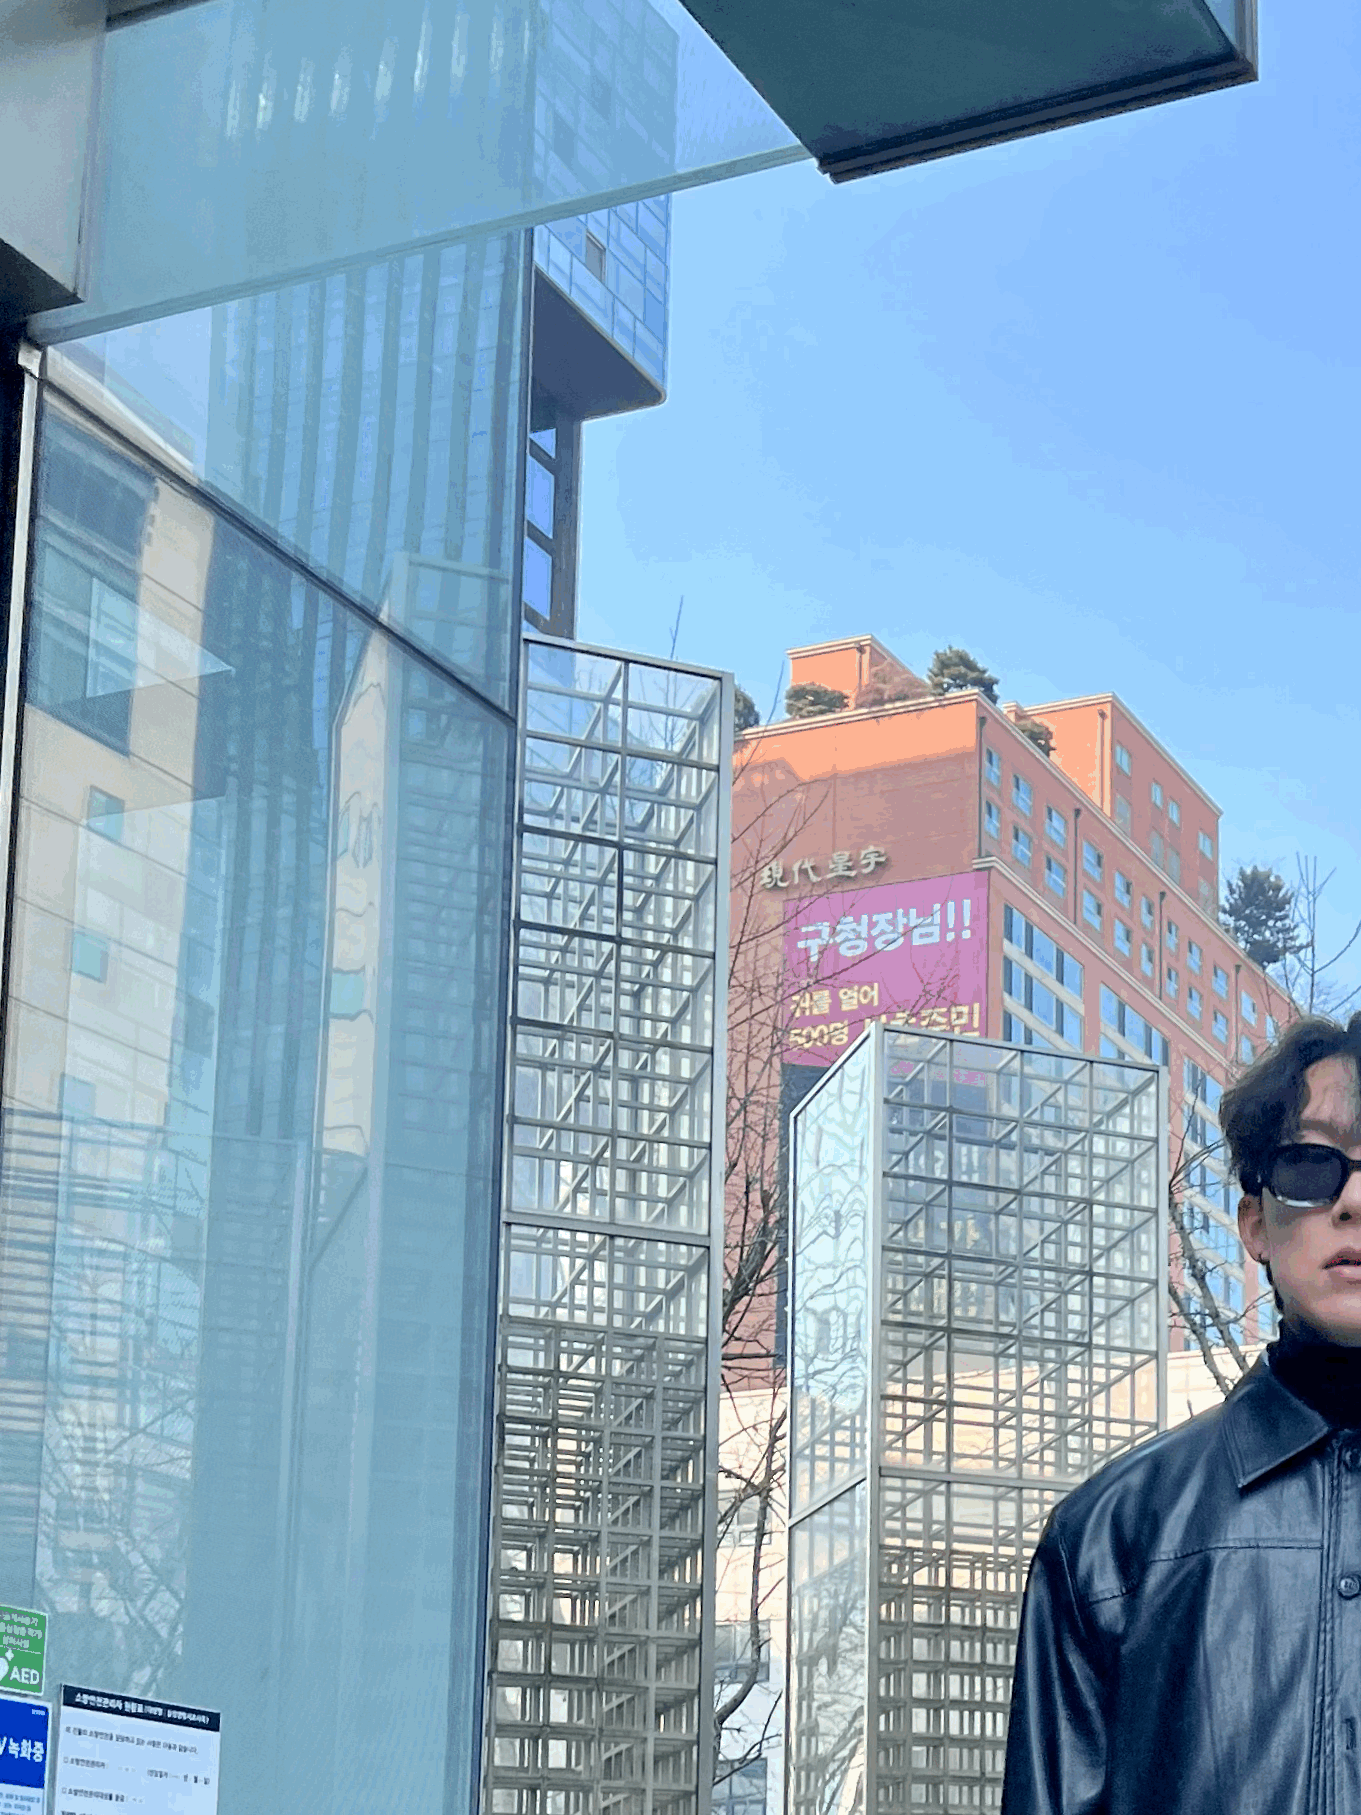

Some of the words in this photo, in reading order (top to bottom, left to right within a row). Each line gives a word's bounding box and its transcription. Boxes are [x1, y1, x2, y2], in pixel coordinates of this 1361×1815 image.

[796, 898, 972, 961] 구청장님!!
[838, 982, 879, 1012] 열어
[789, 1019, 849, 1048] 500명
[10, 1665, 40, 1685] AED
[8, 1737, 44, 1762] 녹화중
